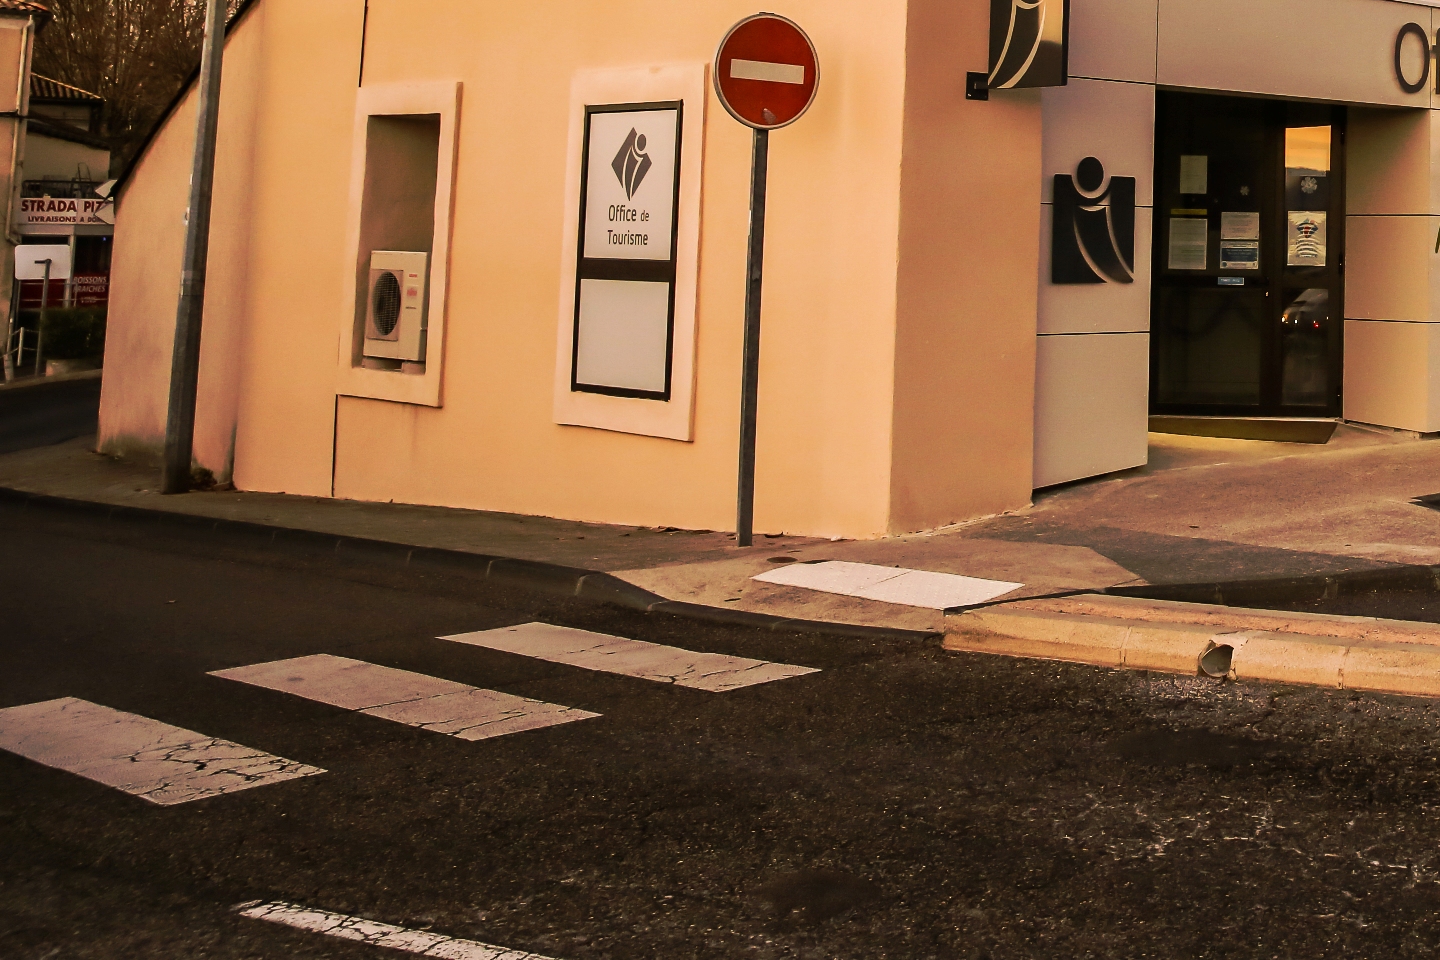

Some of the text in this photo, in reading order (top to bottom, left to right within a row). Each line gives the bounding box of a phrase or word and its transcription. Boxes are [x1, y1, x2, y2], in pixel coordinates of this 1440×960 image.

[21, 199, 77, 212] STRADA
[608, 204, 650, 222] Office de
[28, 215, 76, 223] LIVRAISONS
[607, 229, 649, 246] Tourisme
